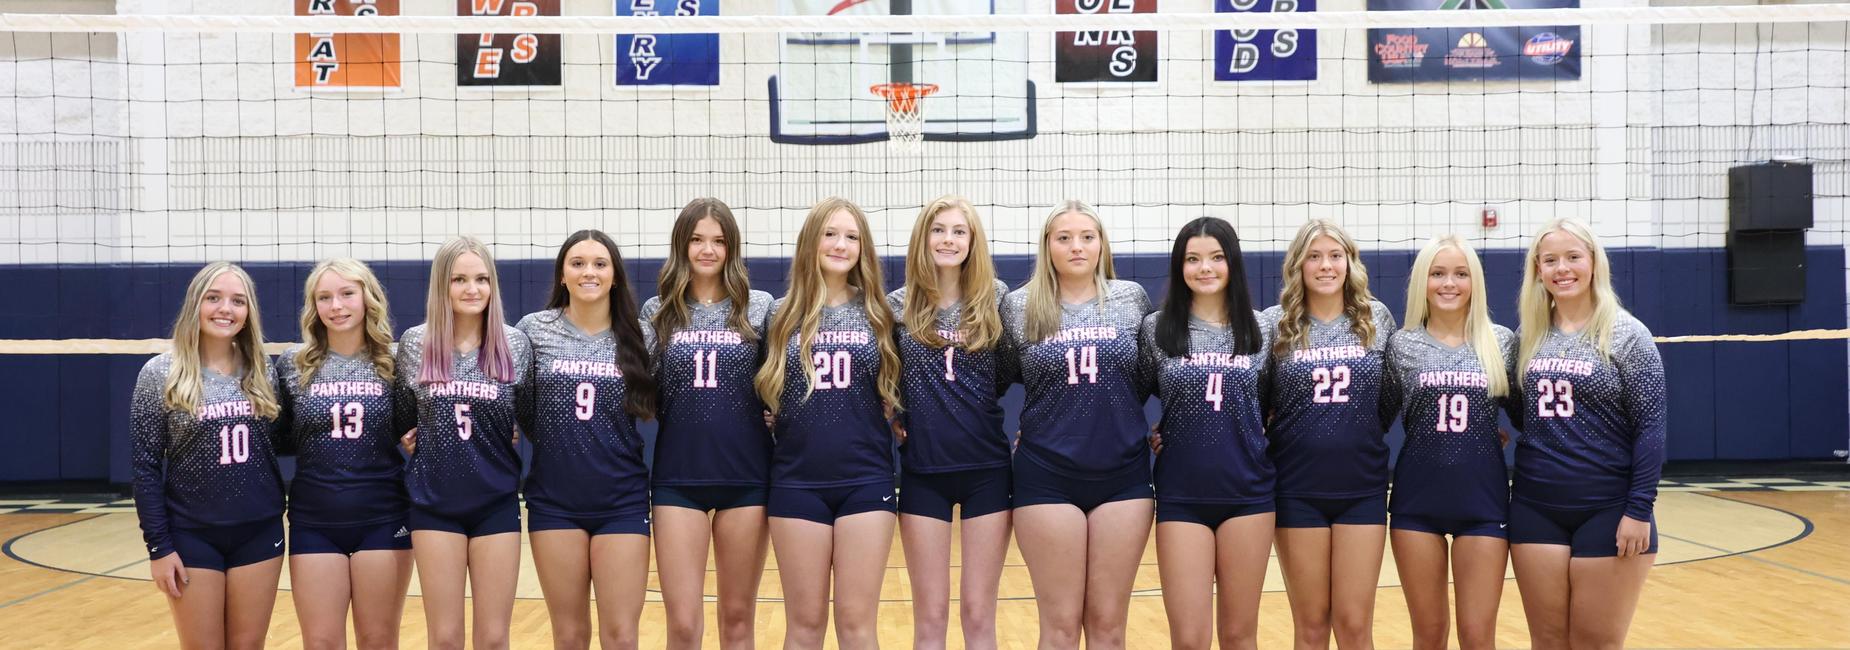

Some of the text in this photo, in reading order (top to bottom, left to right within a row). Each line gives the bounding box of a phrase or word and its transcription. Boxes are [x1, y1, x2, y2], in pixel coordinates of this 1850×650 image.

[671, 330, 742, 345] PANTHERS
[796, 330, 869, 346] NTHERS
[1293, 345, 1366, 362] PANTHERS
[693, 349, 718, 388] 11
[813, 350, 852, 390] 20
[944, 346, 956, 382] 1
[1064, 345, 1099, 385] 14
[1419, 370, 1489, 388] PANTHERS
[1526, 357, 1594, 376] PANTHERS
[310, 381, 383, 397] PANTHERS
[429, 380, 498, 400] PANTHERS
[575, 381, 596, 421] 9
[1205, 372, 1223, 412] 4
[1311, 365, 1352, 404] 22
[1537, 378, 1575, 418] 23
[329, 401, 365, 439] 13
[453, 403, 473, 441] 5
[1435, 393, 1469, 433] 19
[219, 423, 249, 465] 10
